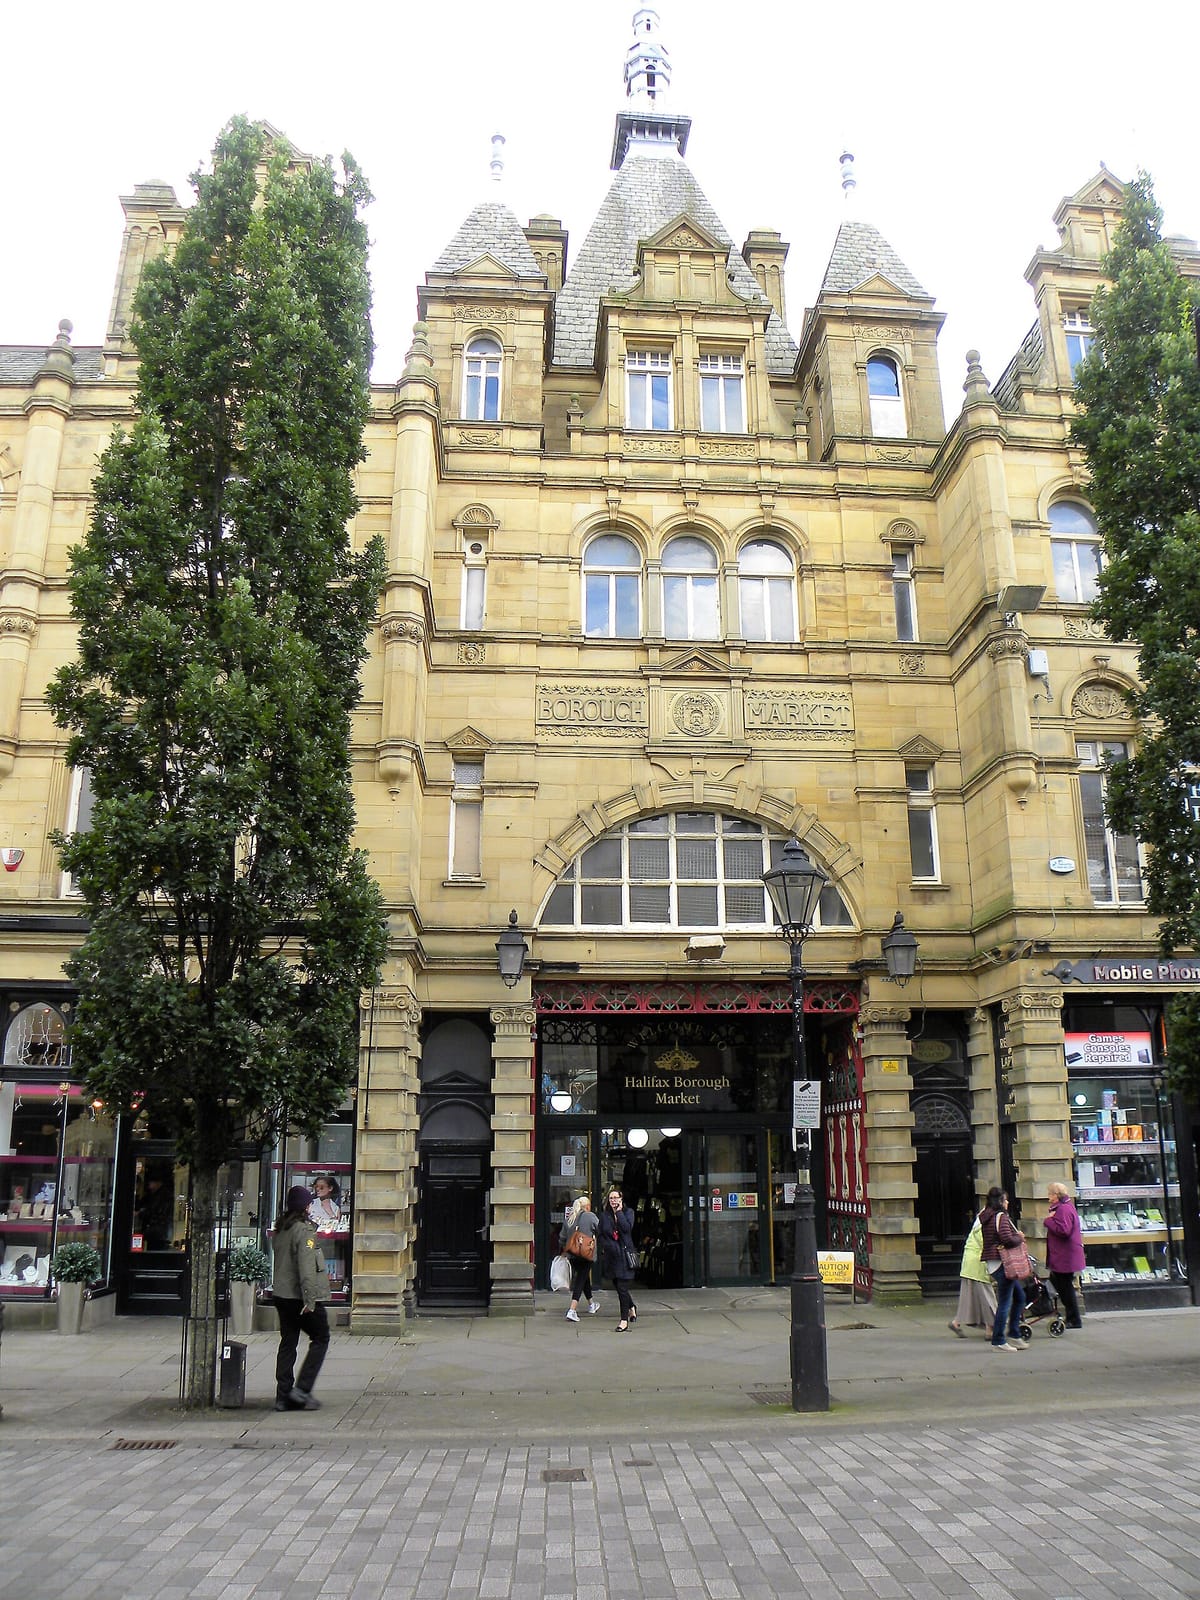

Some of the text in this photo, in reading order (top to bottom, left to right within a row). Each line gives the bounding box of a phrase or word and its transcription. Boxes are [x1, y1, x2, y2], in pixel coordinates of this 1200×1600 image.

[538, 698, 646, 723] BOROUGH
[747, 702, 850, 726] MARKET
[1093, 963, 1153, 981] Mobile
[1088, 1033, 1125, 1044] Games
[1083, 1043, 1132, 1053] Consoles
[1084, 1052, 1132, 1064] Repaired
[624, 1075, 731, 1091] Halifax Borough
[655, 1091, 701, 1105] Market
[819, 1263, 850, 1271] AUTION
[224, 1348, 230, 1357] 7
